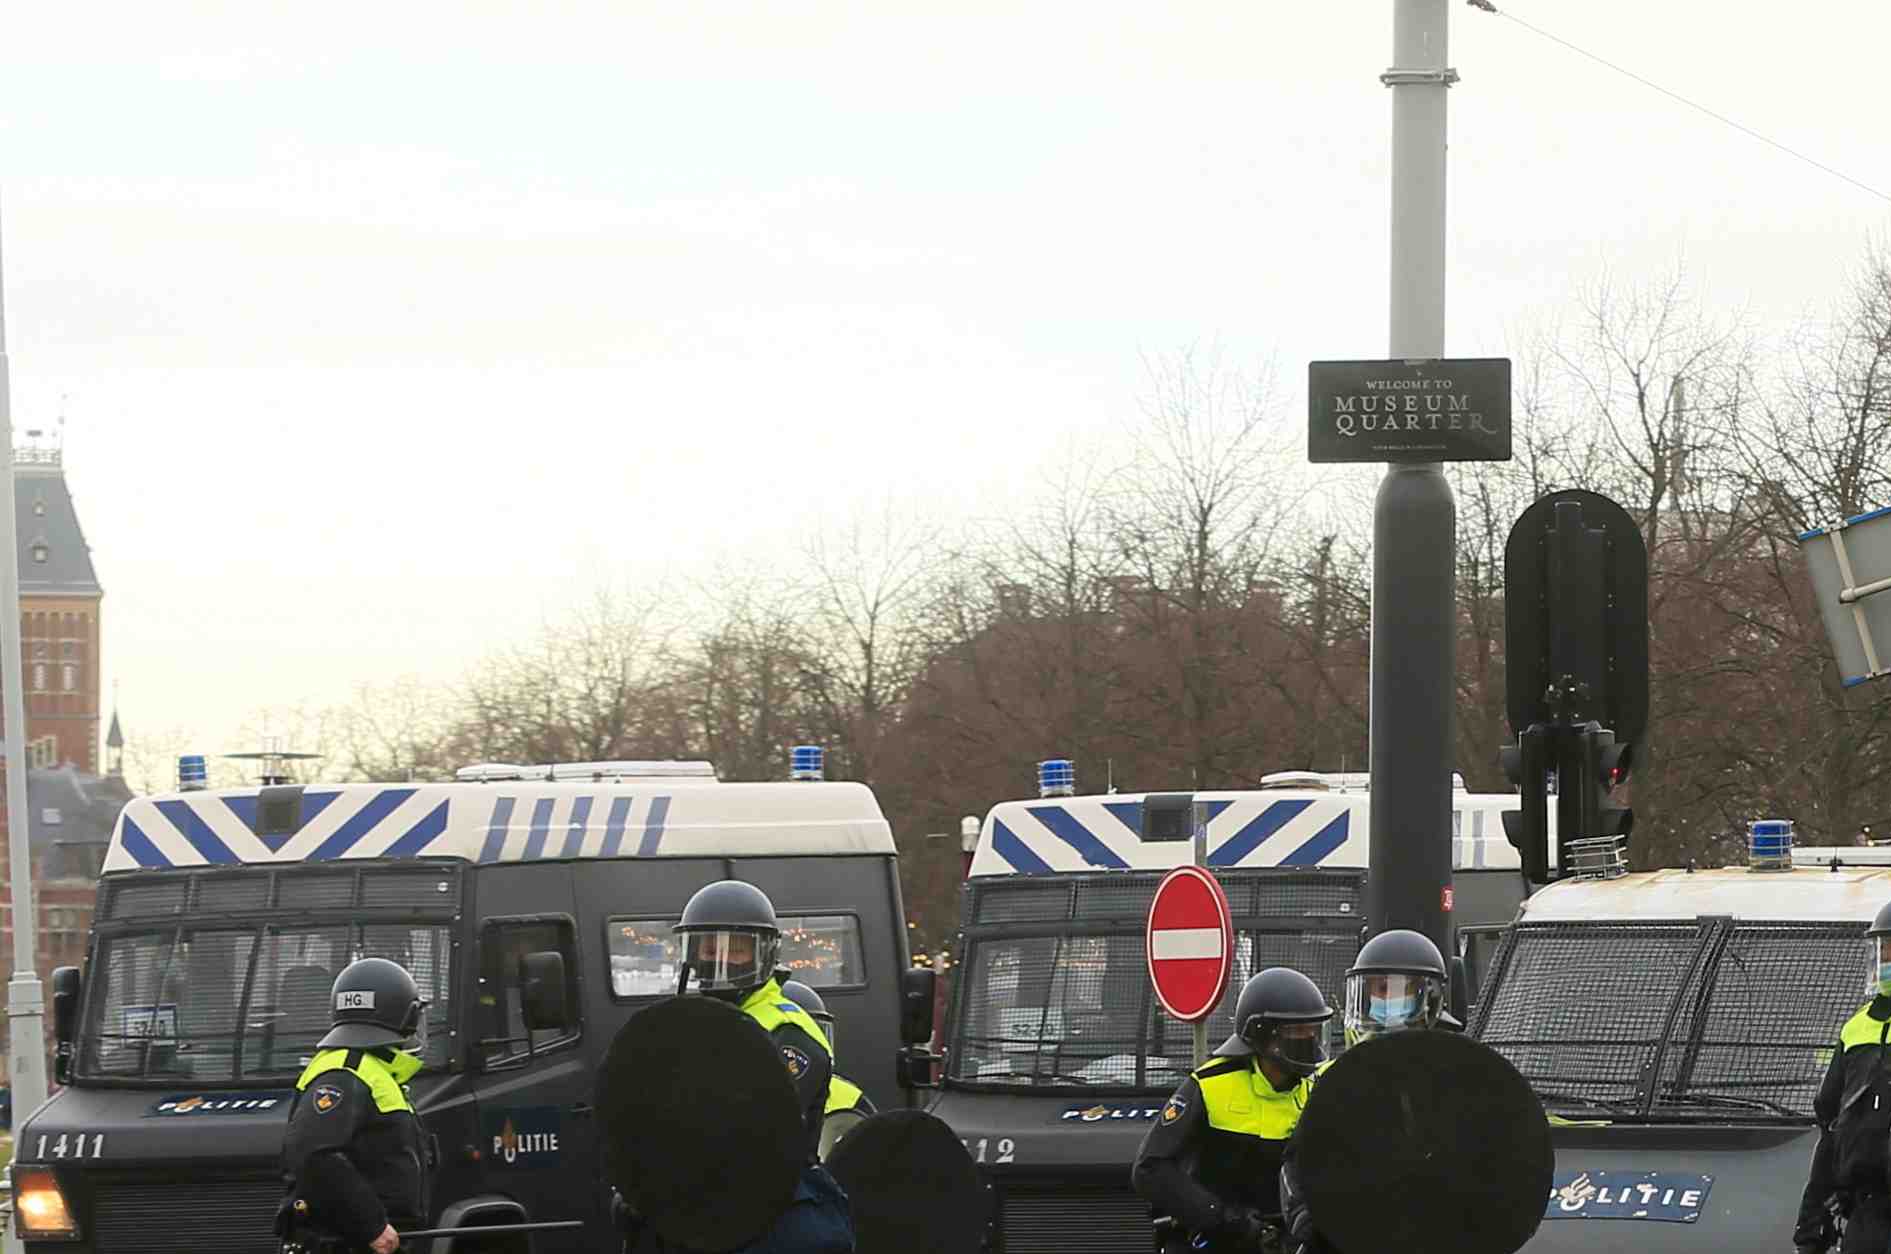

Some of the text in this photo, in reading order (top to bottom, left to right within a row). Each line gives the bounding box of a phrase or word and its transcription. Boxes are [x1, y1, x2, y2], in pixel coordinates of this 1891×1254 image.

[1366, 379, 1452, 390] WELCOME TO
[1335, 395, 1470, 412] MUSEUM
[1336, 413, 1498, 436] QUARTER
[345, 994, 362, 1006] HG
[158, 1097, 278, 1113] POLITIE
[1062, 1107, 1159, 1121] POLIT
[36, 1133, 104, 1159] 1411
[493, 1133, 559, 1162] POLITIE
[962, 1138, 1015, 1163] 12
